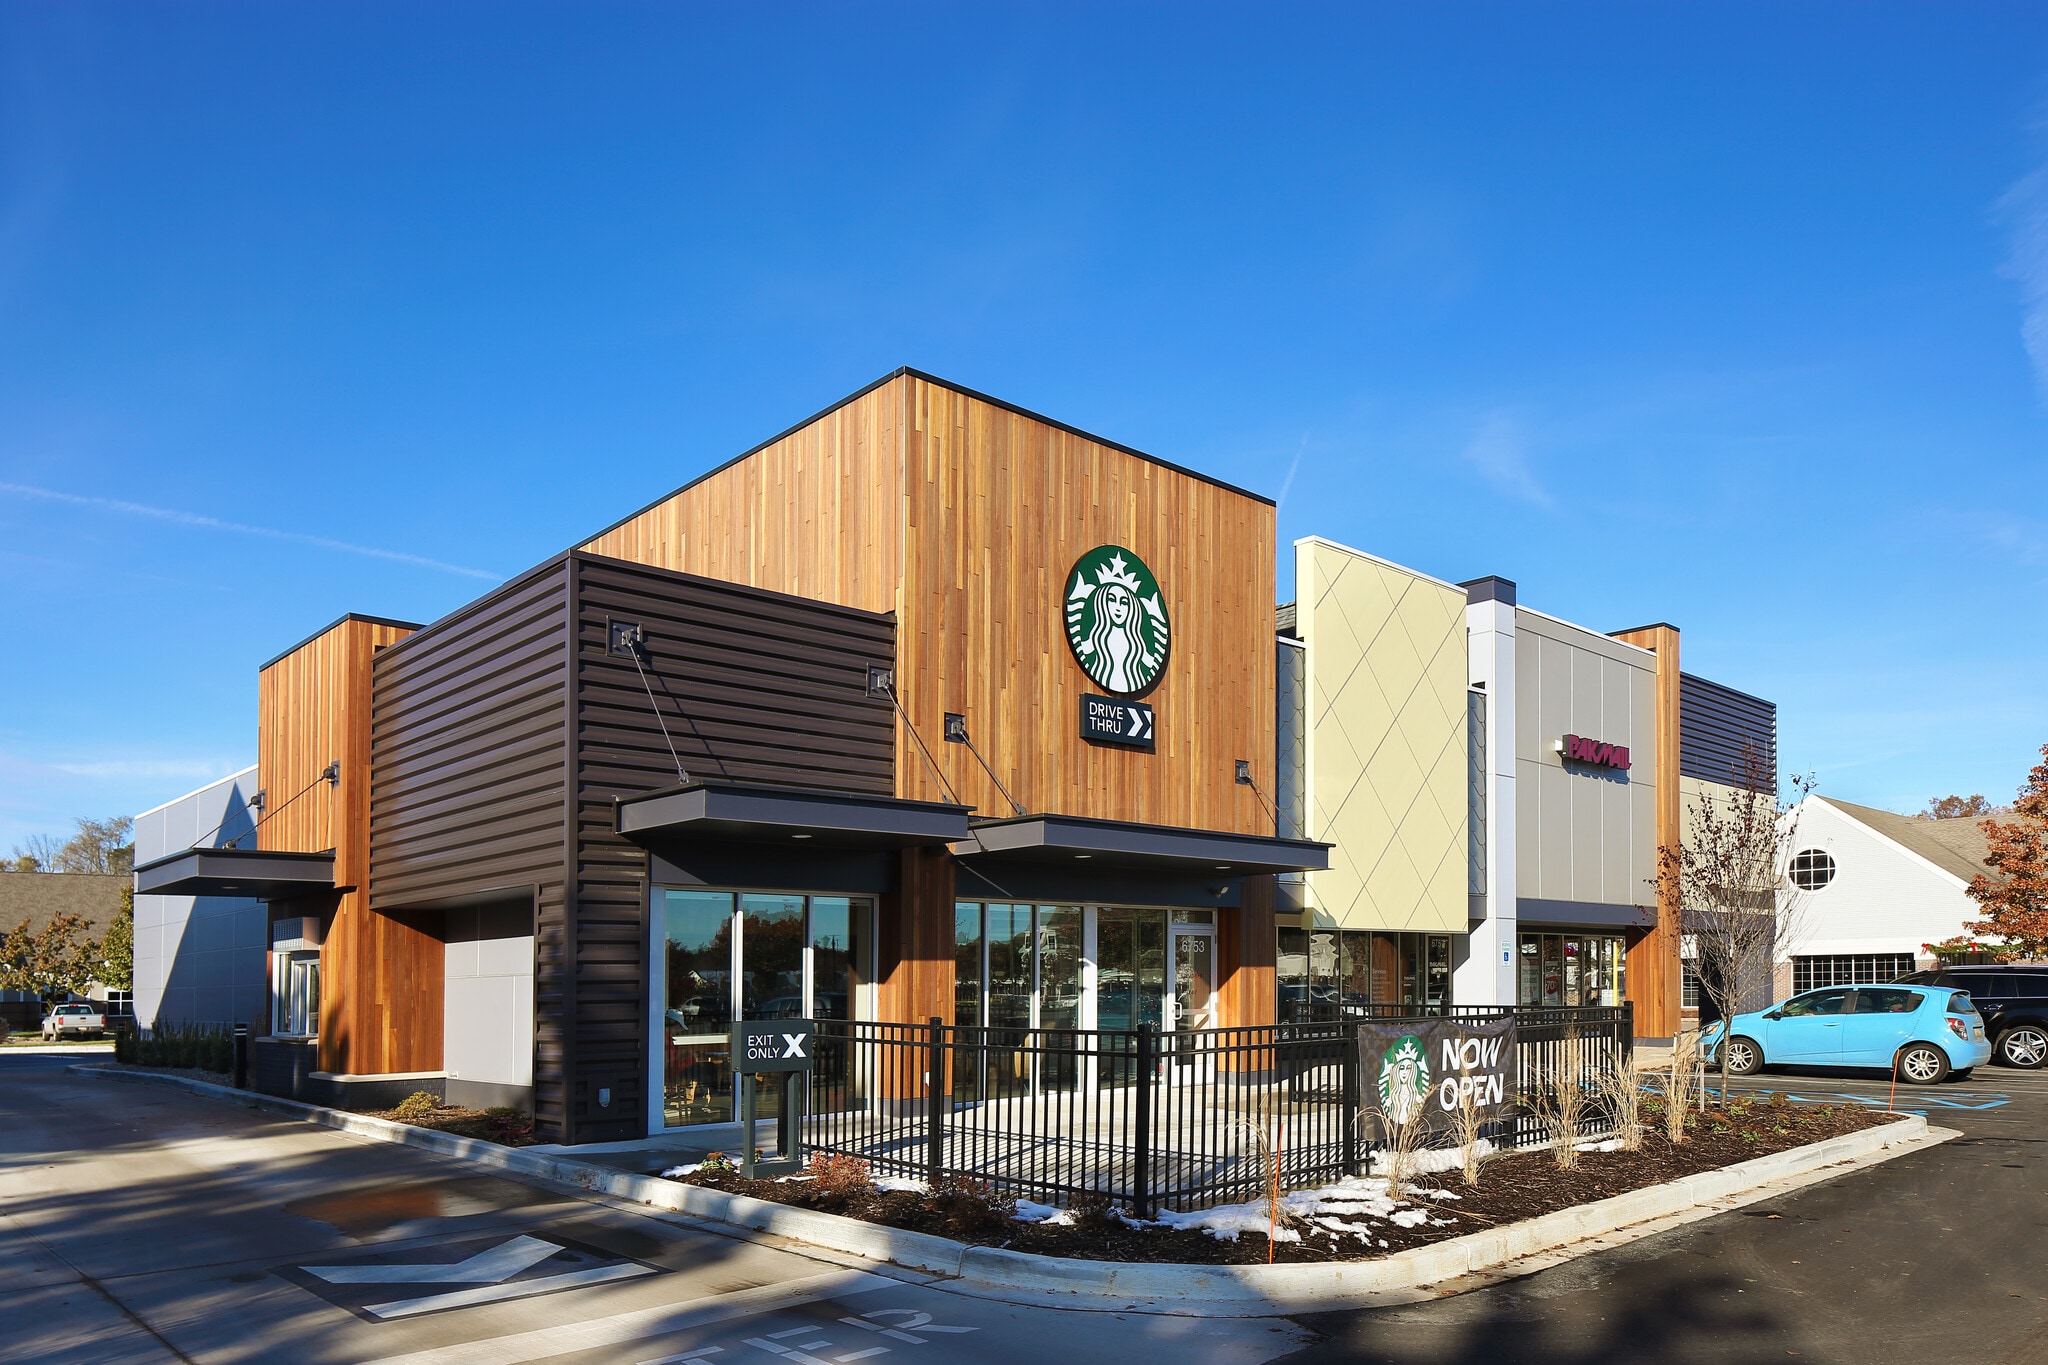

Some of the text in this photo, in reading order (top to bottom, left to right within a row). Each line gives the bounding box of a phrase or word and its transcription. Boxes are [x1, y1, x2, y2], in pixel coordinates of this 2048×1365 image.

[1089, 701, 1124, 720] DRIVE
[1089, 716, 1122, 734] THRU
[1181, 940, 1205, 953] 6753
[748, 1034, 774, 1047] EXIT
[747, 1047, 780, 1060] ONLY
[1441, 1036, 1504, 1072] NOW
[1439, 1072, 1505, 1112] OPEN
